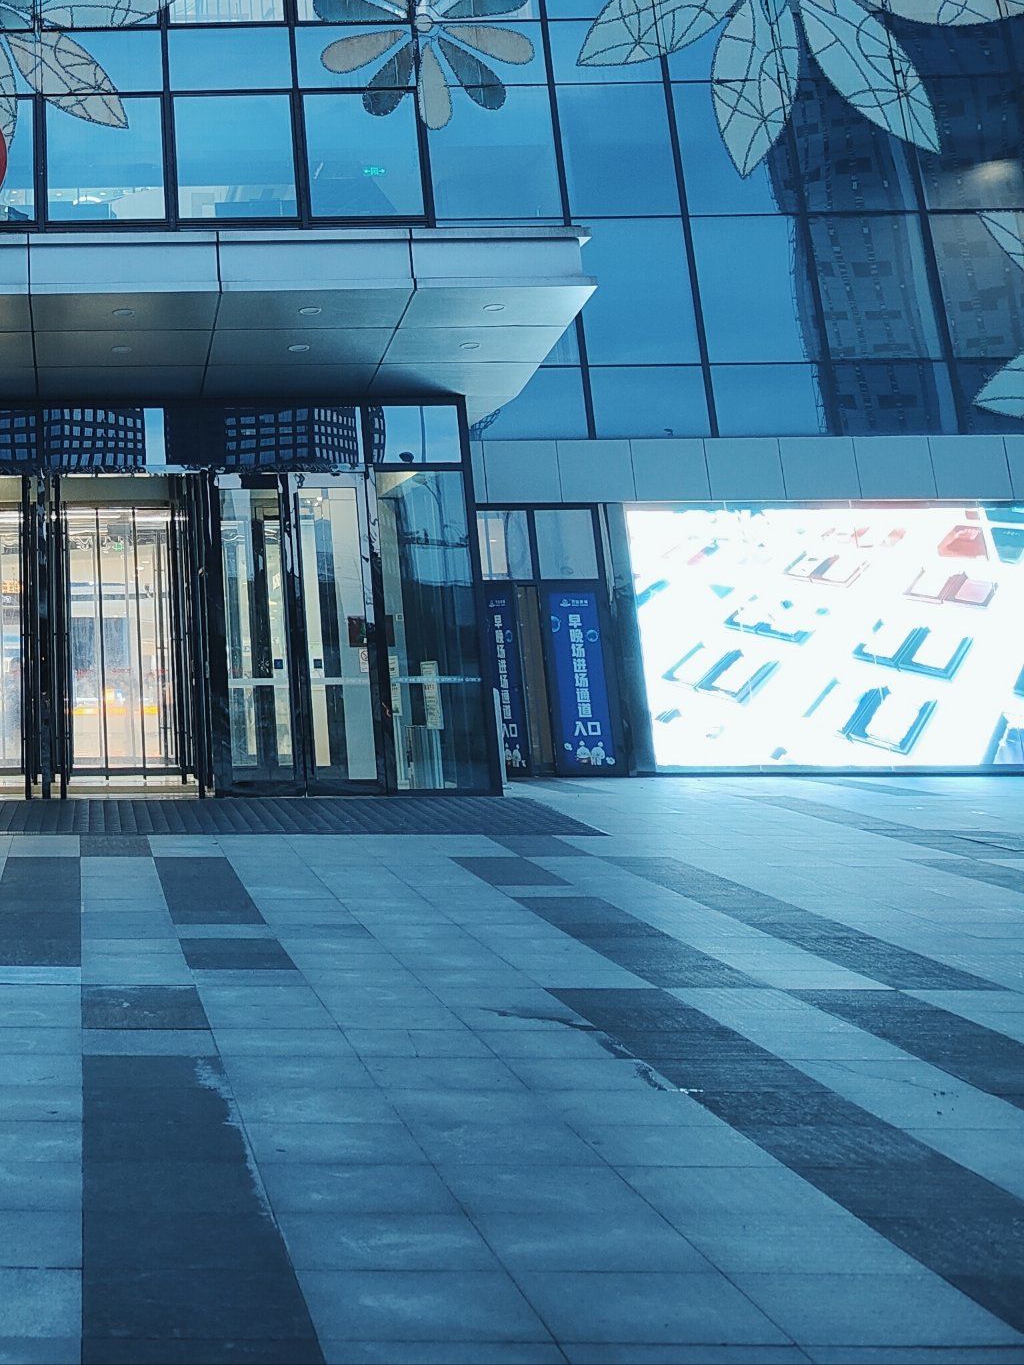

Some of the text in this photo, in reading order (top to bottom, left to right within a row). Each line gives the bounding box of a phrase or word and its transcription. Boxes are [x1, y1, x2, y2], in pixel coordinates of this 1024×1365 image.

[494, 614, 512, 720] 早晚场进场通道
[568, 614, 593, 718] 早晚场进场通道
[574, 721, 602, 736] 入口
